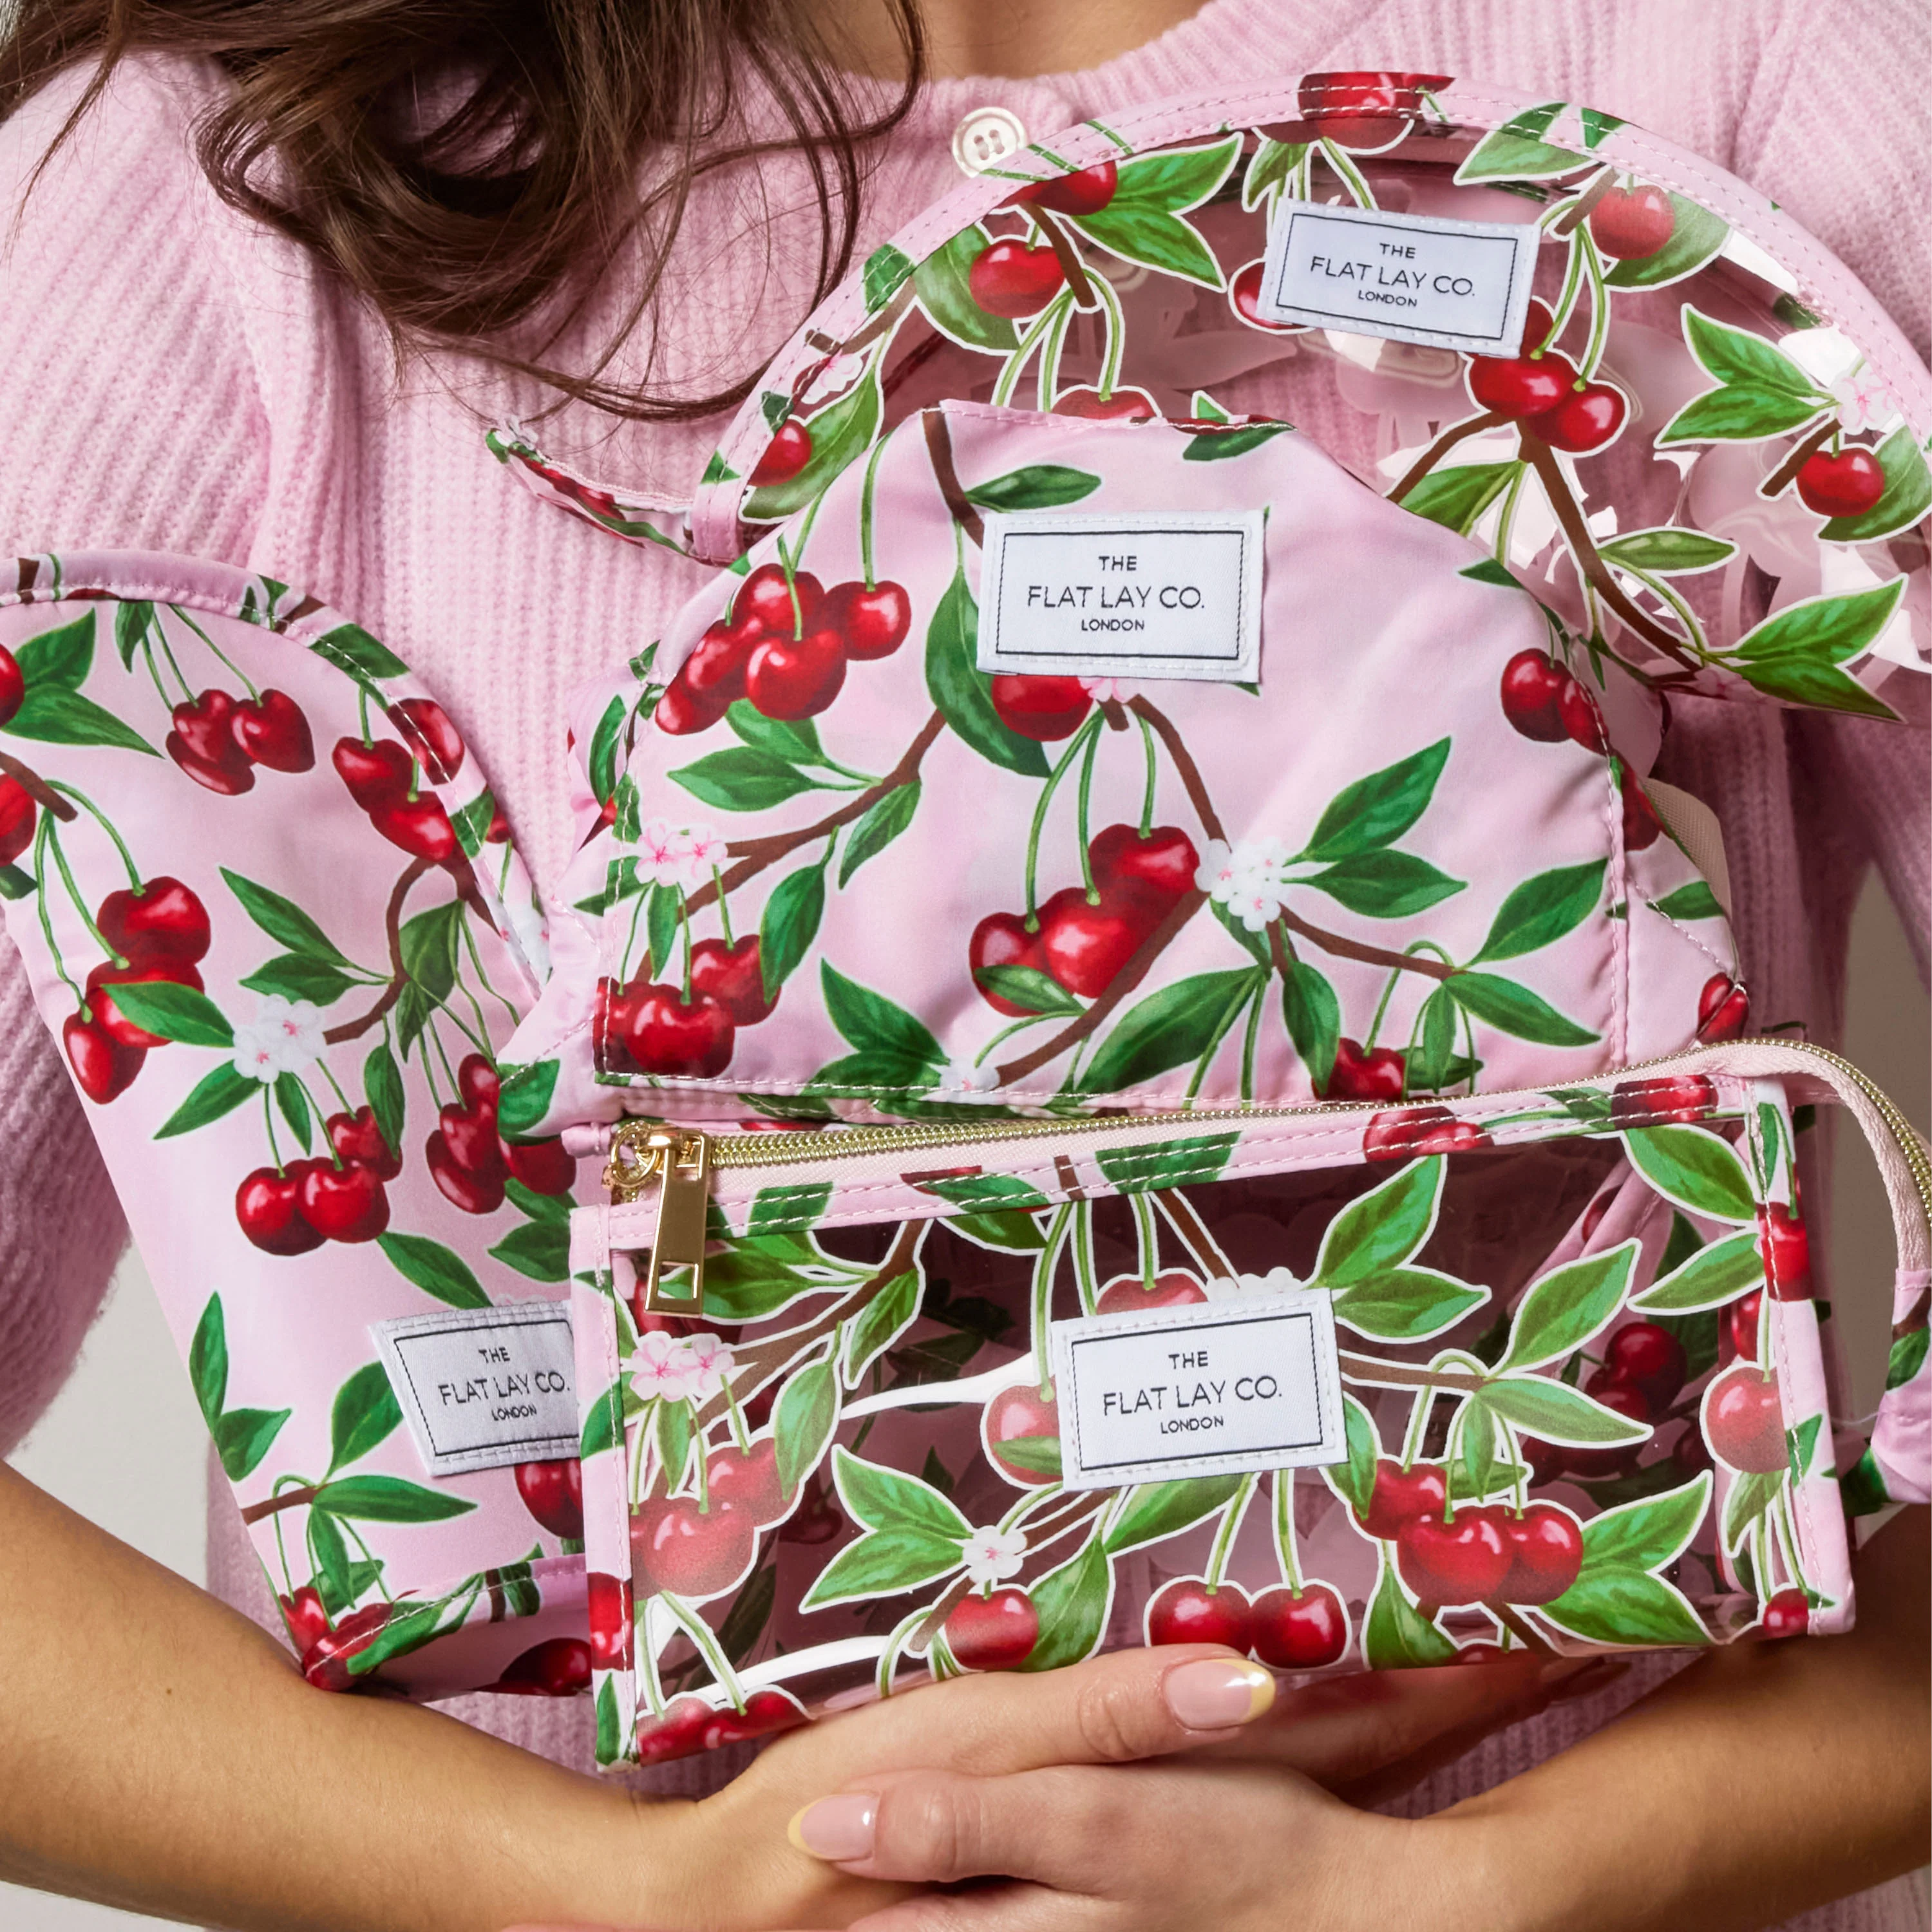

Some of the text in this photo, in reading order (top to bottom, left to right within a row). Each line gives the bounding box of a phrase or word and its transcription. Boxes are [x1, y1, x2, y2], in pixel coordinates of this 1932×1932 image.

[1379, 243, 1416, 258] THE
[1310, 256, 1475, 296] FLAT LAY CO.
[1358, 290, 1417, 307] LONDON
[1098, 556, 1137, 571] THE
[1028, 586, 1205, 609] FLAT LAY CO.
[1081, 619, 1145, 631] LONDON
[478, 1347, 511, 1364] THE
[1168, 1351, 1208, 1369] THE
[438, 1371, 571, 1405] FLAT LAY CO.
[1103, 1376, 1282, 1416] FLAT LAY CO.
[491, 1405, 537, 1421] LONDON
[1160, 1416, 1224, 1434] LONDON
